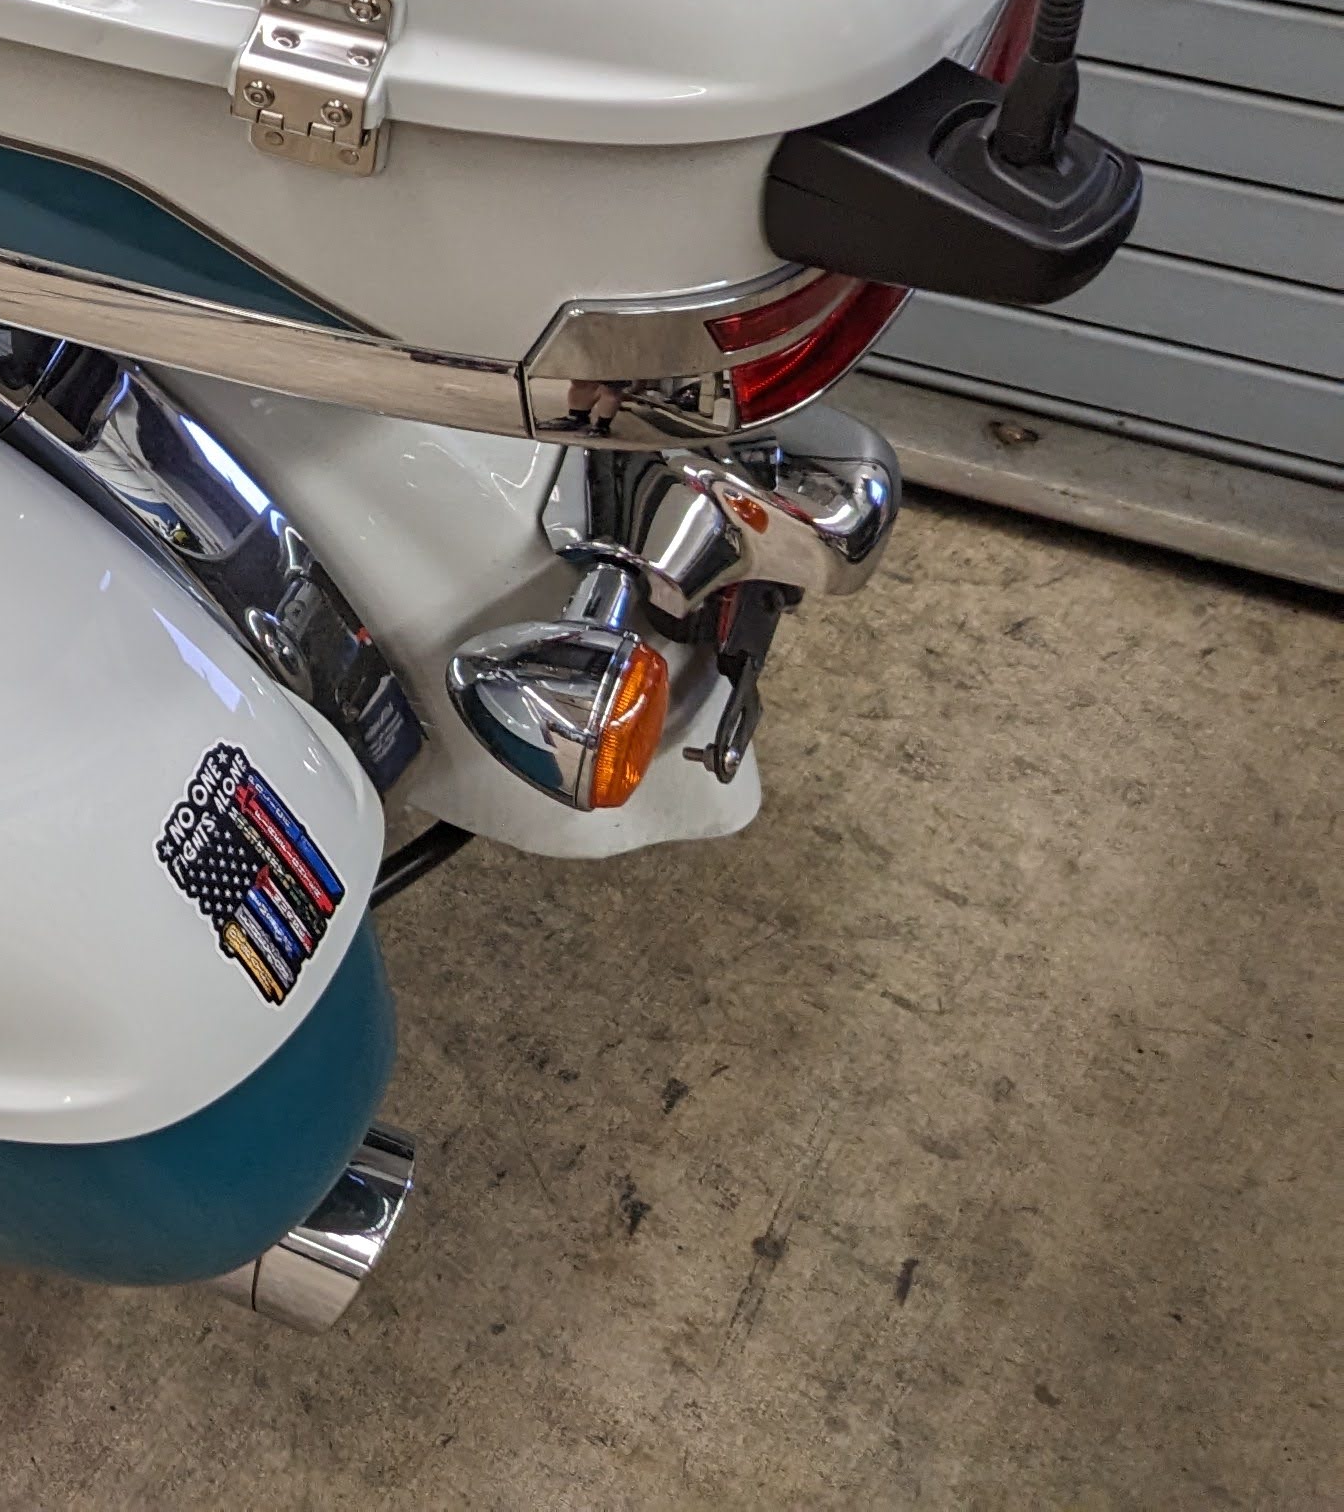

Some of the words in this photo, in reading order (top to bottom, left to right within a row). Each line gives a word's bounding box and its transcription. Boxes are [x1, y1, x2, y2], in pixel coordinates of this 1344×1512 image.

[168, 806, 195, 840] NO
[191, 756, 222, 806] ONE
[172, 811, 216, 884] FIGHTS
[214, 753, 248, 814] ALONE
